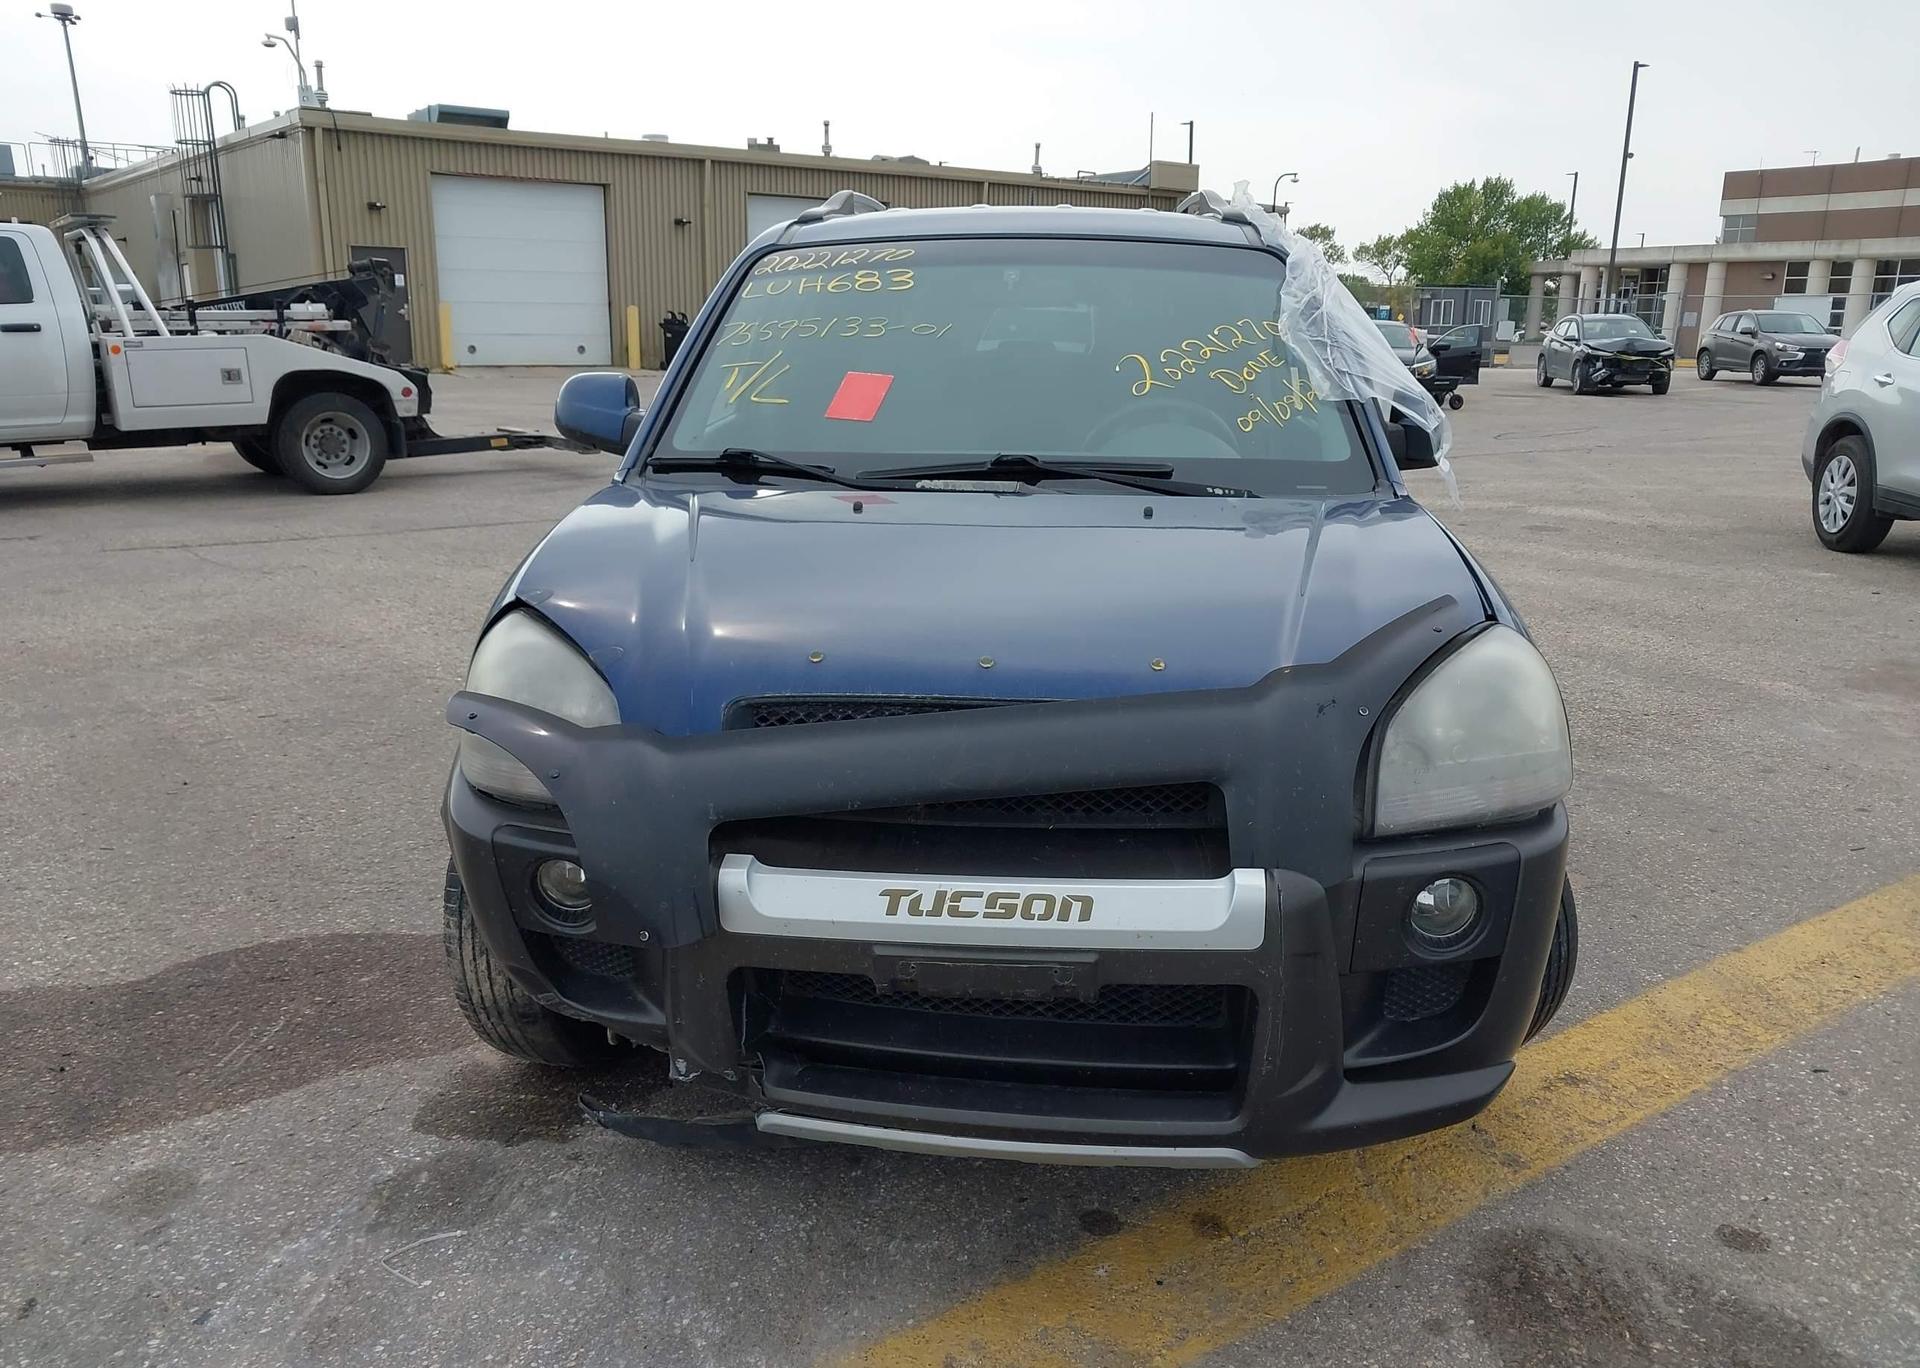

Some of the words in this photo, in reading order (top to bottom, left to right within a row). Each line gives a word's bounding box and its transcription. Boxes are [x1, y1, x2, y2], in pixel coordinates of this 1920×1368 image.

[755, 249, 915, 275] 20221270
[741, 269, 915, 299] LUH683
[1115, 318, 1282, 396] 20221270
[720, 350, 790, 404] T/L
[878, 888, 1094, 922] TUCSON
